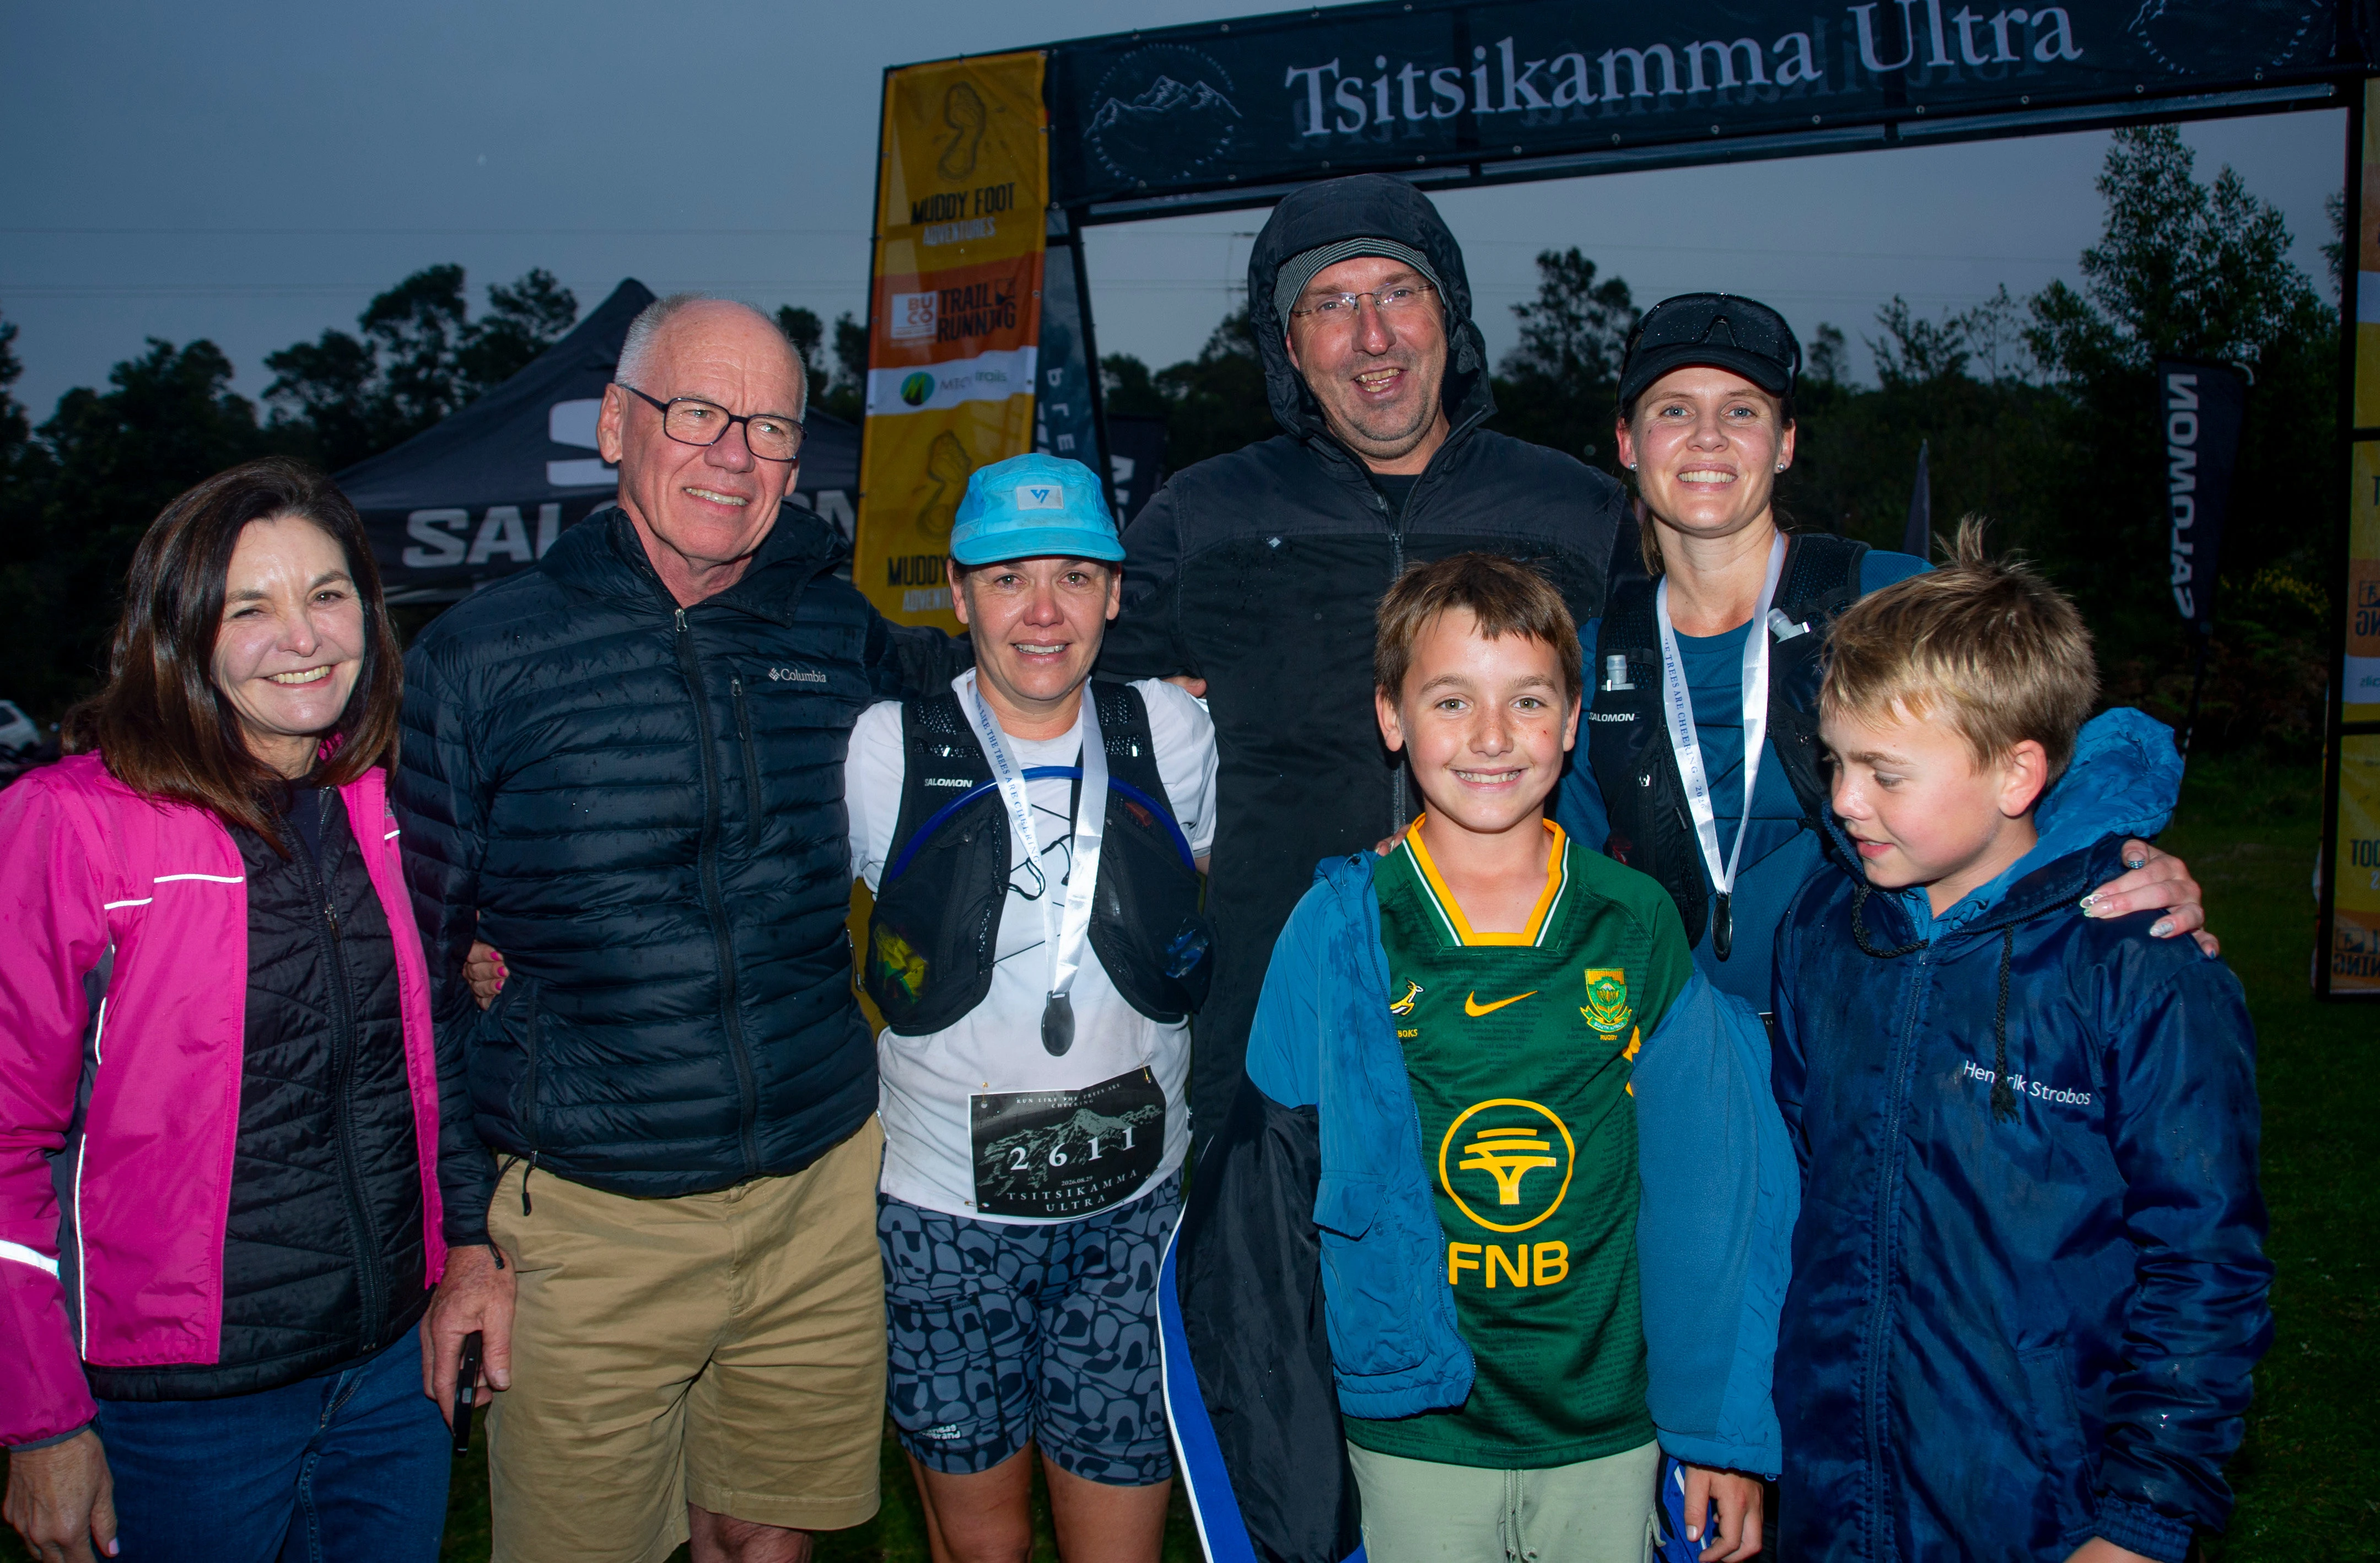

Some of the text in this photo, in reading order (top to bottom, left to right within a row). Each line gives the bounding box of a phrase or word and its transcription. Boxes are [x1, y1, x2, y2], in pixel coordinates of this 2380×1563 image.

[1285, 31, 1823, 138] Tsitsikamma
[1848, 0, 2083, 73] Ultra
[911, 182, 1015, 225] MUDDY FOOT
[922, 217, 995, 246] ADVENTURES
[940, 283, 992, 315] TRAIL
[938, 301, 1016, 342] RUNNING
[780, 669, 826, 683] Columbia
[1665, 655, 1679, 688] TREES
[1674, 689, 1684, 710] ARE
[1589, 712, 1635, 722] SALOMON
[1676, 711, 1698, 773] CHEERING
[924, 778, 973, 788] SALOMON
[979, 709, 990, 730] LIKE
[987, 729, 998, 748] THE
[993, 747, 1010, 774] TREES
[1005, 777, 1019, 799] ARE
[1014, 801, 1040, 863] CHEERING
[1397, 1029, 1418, 1038] BOKS
[1084, 1088, 1105, 1100] TREES
[1108, 1082, 1121, 1091] ARE
[1964, 1060, 2092, 1105] Henrik Strobos
[1051, 1098, 1094, 1108] CHEERING
[1010, 1126, 1136, 1171] 2611
[1006, 1169, 1138, 1200] TSITSIKAMMA
[1060, 1176, 1094, 1186] 2026.08.29
[1046, 1194, 1106, 1212] ULTRA
[1449, 1241, 1569, 1288] FNB
